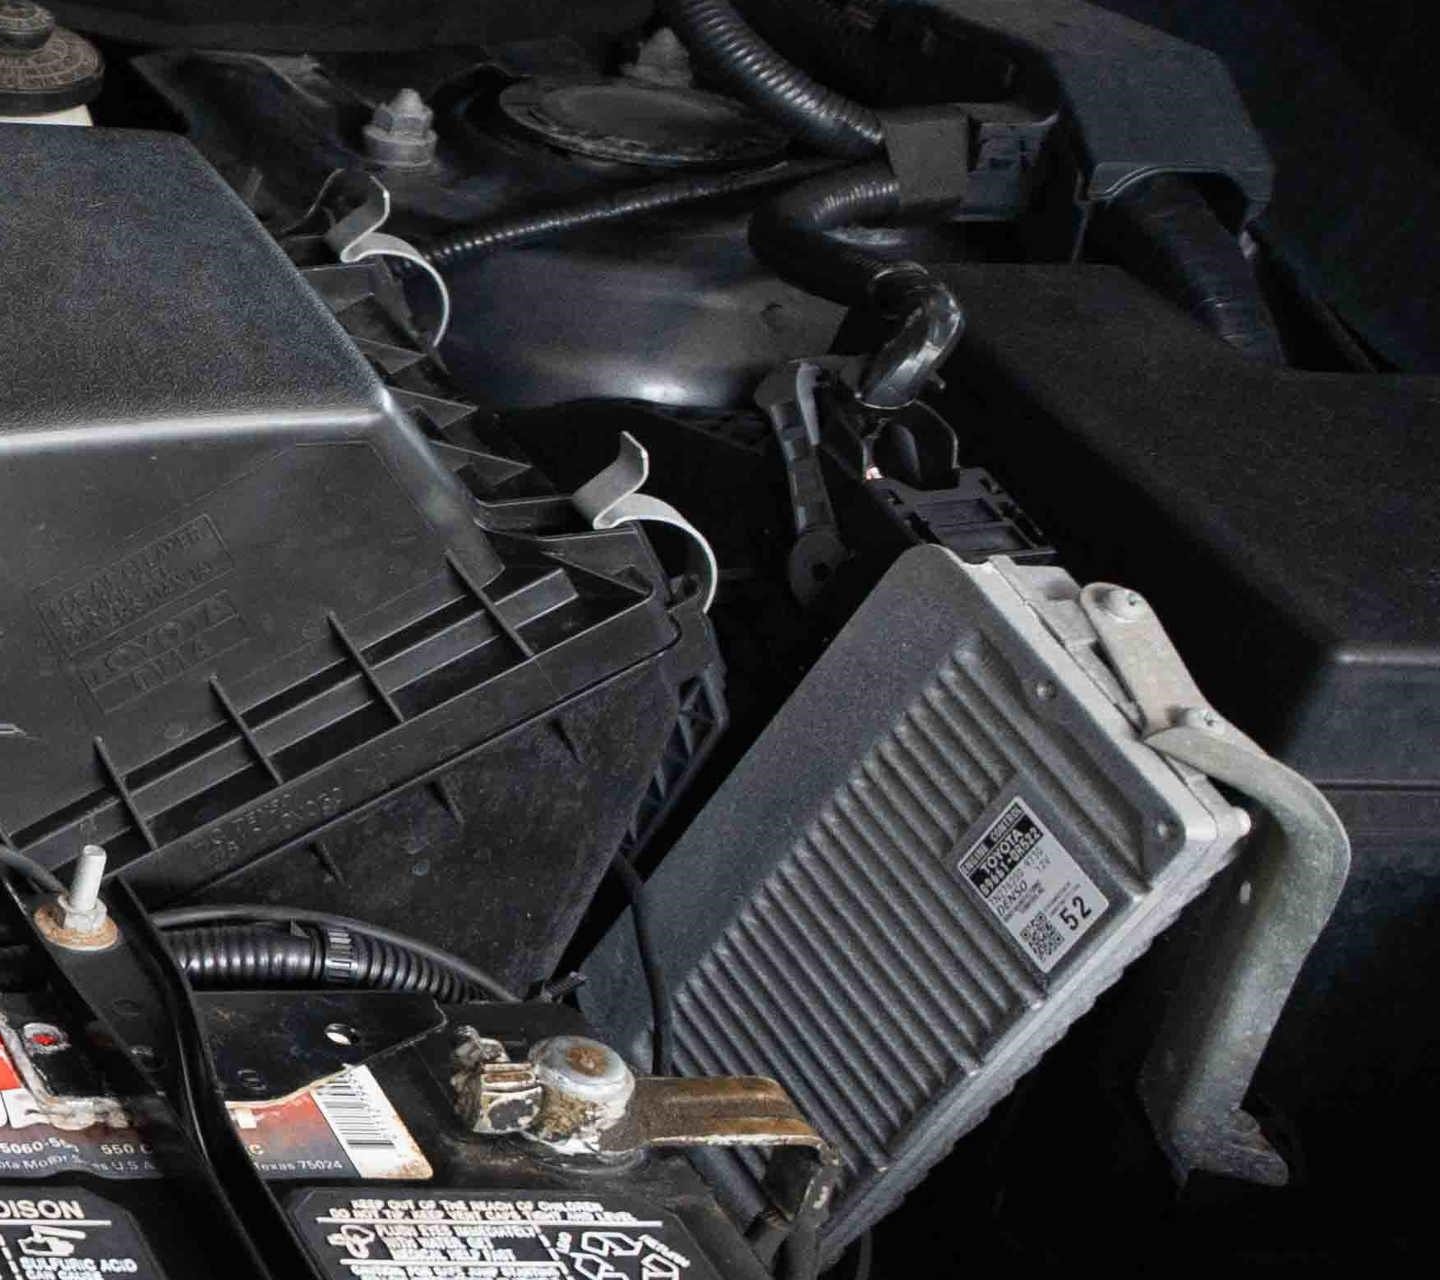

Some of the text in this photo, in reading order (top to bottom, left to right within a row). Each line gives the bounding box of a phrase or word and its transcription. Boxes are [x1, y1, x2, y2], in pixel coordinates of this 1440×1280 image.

[985, 828, 1024, 874] TOYOTA
[997, 880, 1029, 916] DENSO
[1059, 895, 1093, 931] 52
[297, 1159, 344, 1170] 75024
[20, 1257, 139, 1273] SULFURIC ACID
